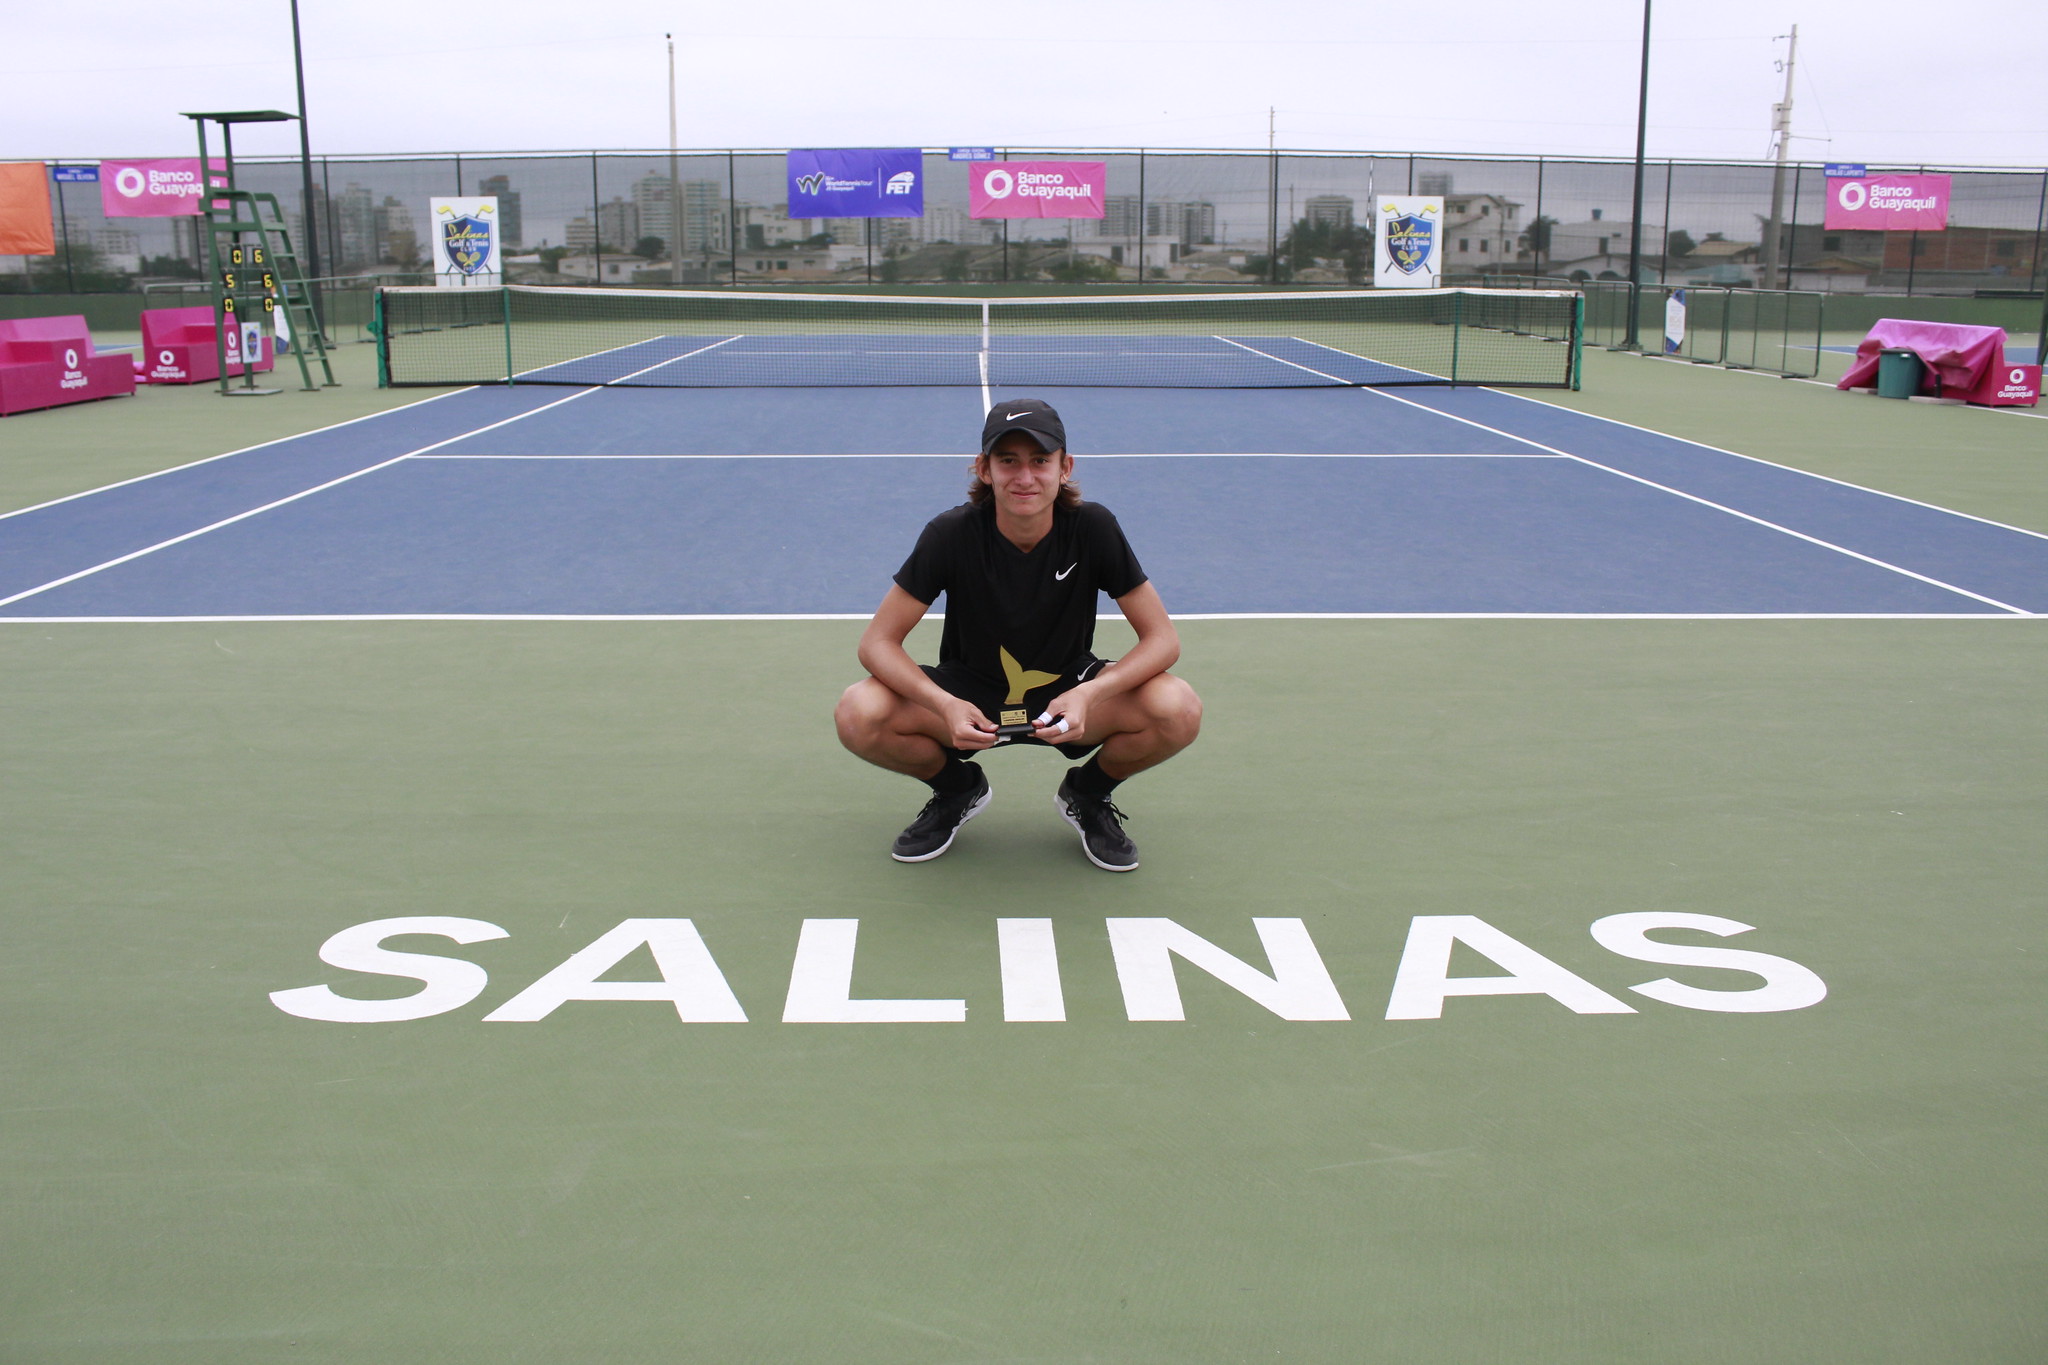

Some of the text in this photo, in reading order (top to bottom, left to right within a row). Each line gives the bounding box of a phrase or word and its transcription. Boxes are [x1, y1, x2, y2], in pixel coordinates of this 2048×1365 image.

[149, 170, 195, 183] Banco
[1017, 172, 1064, 184] Banco
[885, 182, 914, 194] FET
[1017, 183, 1091, 199] Guayaquil
[1870, 185, 1912, 197] Banco
[1869, 196, 1936, 212] Guayaquil
[448, 239, 465, 248] Golf
[1391, 237, 1407, 246] Golf
[233, 249, 263, 264] 0 6
[225, 274, 273, 288] 5 6
[224, 298, 274, 312] 0 0
[1997, 390, 2033, 399] Guayaquil
[268, 911, 1827, 1023] SALINAS
